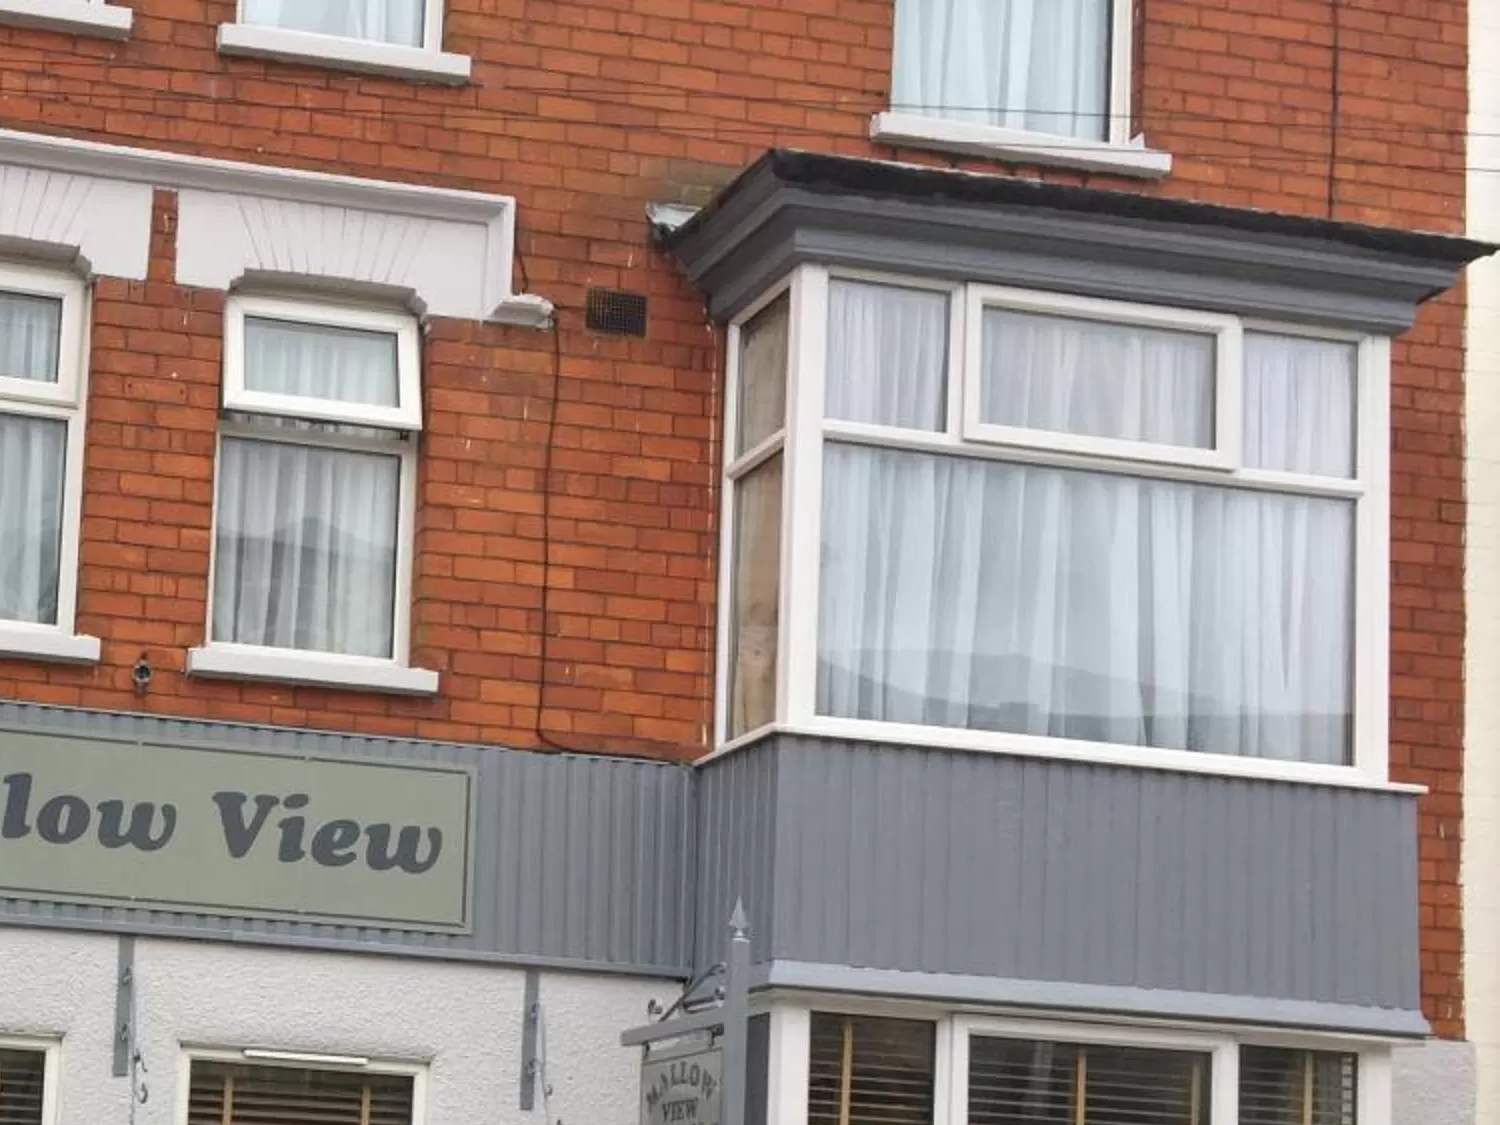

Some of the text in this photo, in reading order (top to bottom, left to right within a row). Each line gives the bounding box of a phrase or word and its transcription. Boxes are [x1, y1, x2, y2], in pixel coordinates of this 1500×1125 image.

[212, 792, 443, 875] View
[646, 1061, 717, 1113] MALLOW
[662, 1097, 699, 1122] VIEW
